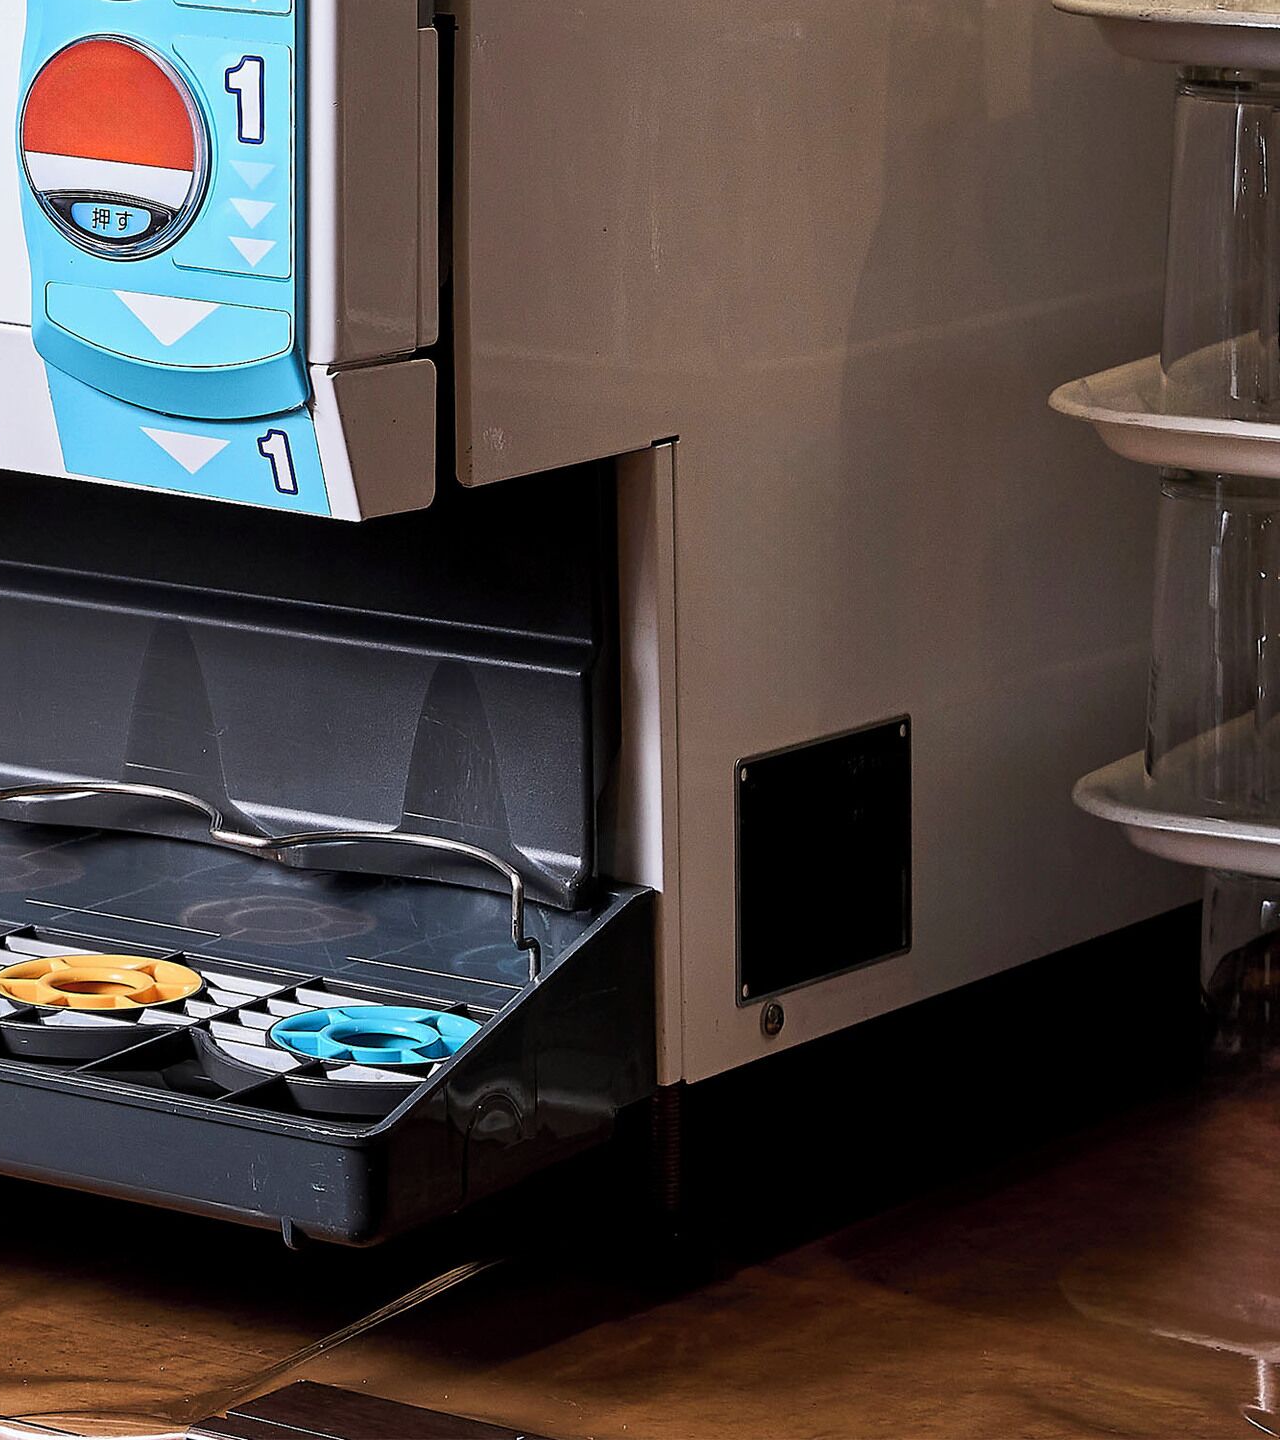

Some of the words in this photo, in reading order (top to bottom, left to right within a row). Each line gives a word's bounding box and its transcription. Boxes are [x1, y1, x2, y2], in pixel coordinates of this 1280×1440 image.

[224, 55, 265, 145] 1
[91, 208, 133, 232] 押す
[257, 428, 298, 495] 1
